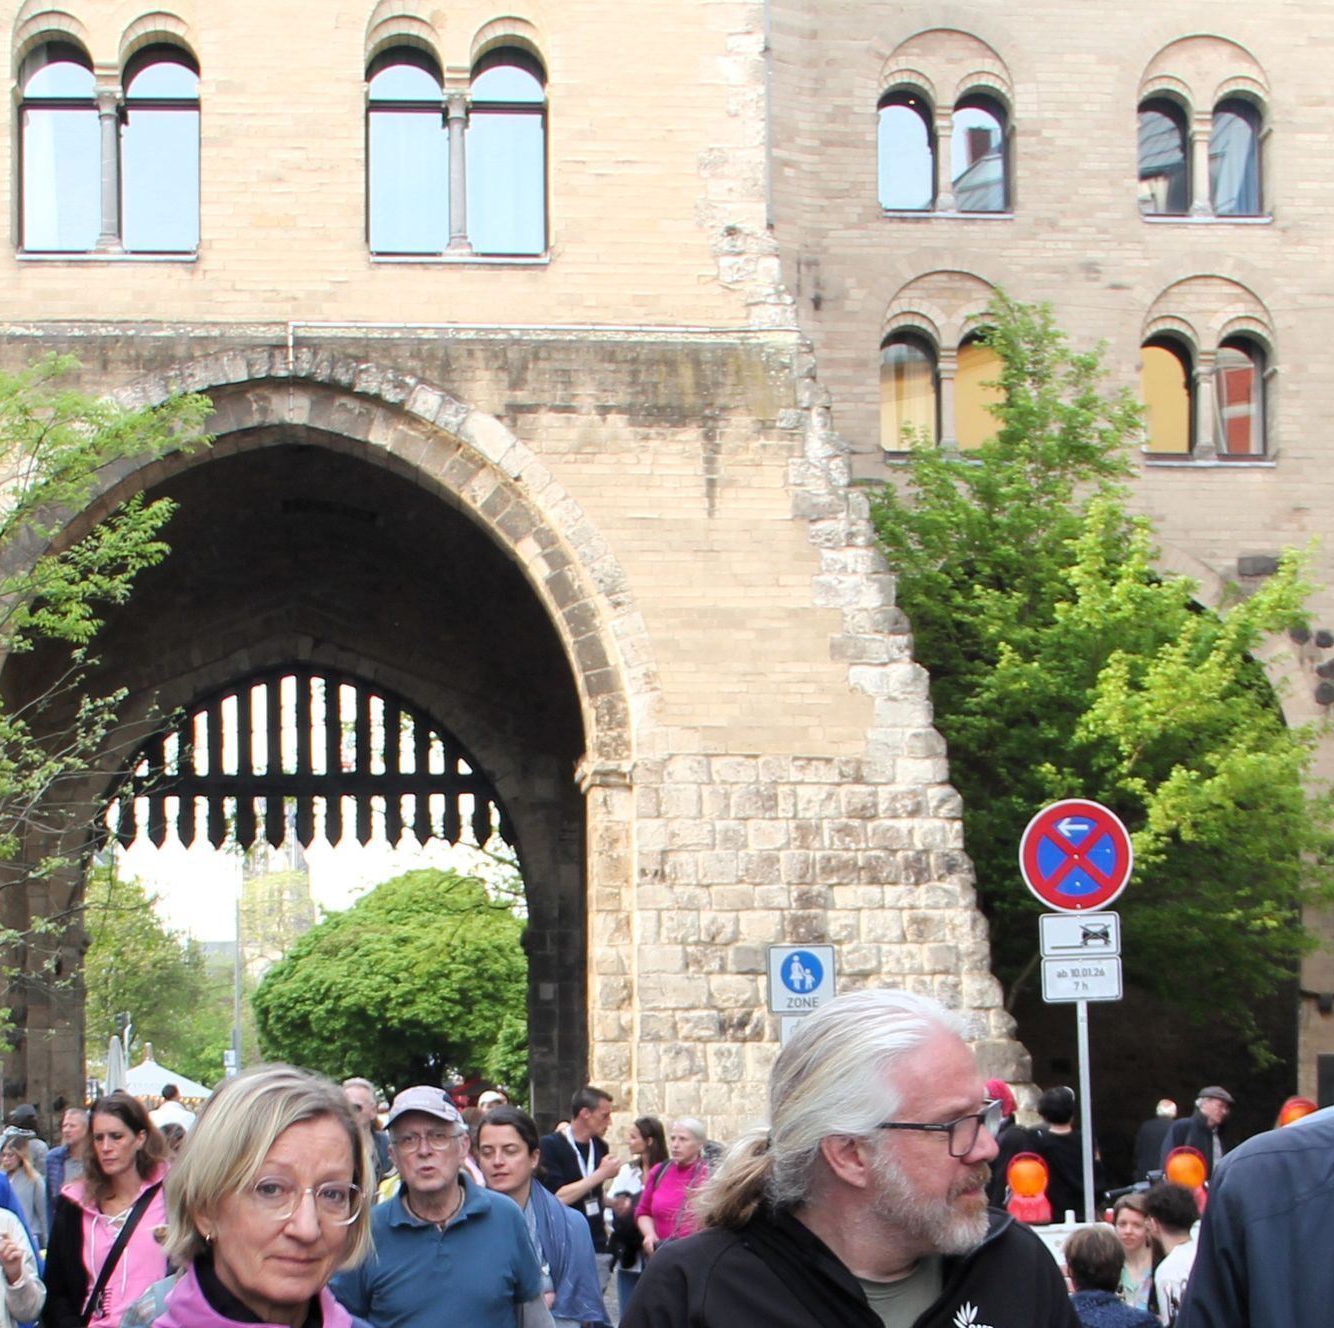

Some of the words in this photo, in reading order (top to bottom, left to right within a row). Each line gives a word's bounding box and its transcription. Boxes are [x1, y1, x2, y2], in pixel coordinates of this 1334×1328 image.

[1073, 981, 1080, 991] 7
[1082, 981, 1089, 991] h
[786, 996, 820, 1009] ZONE
